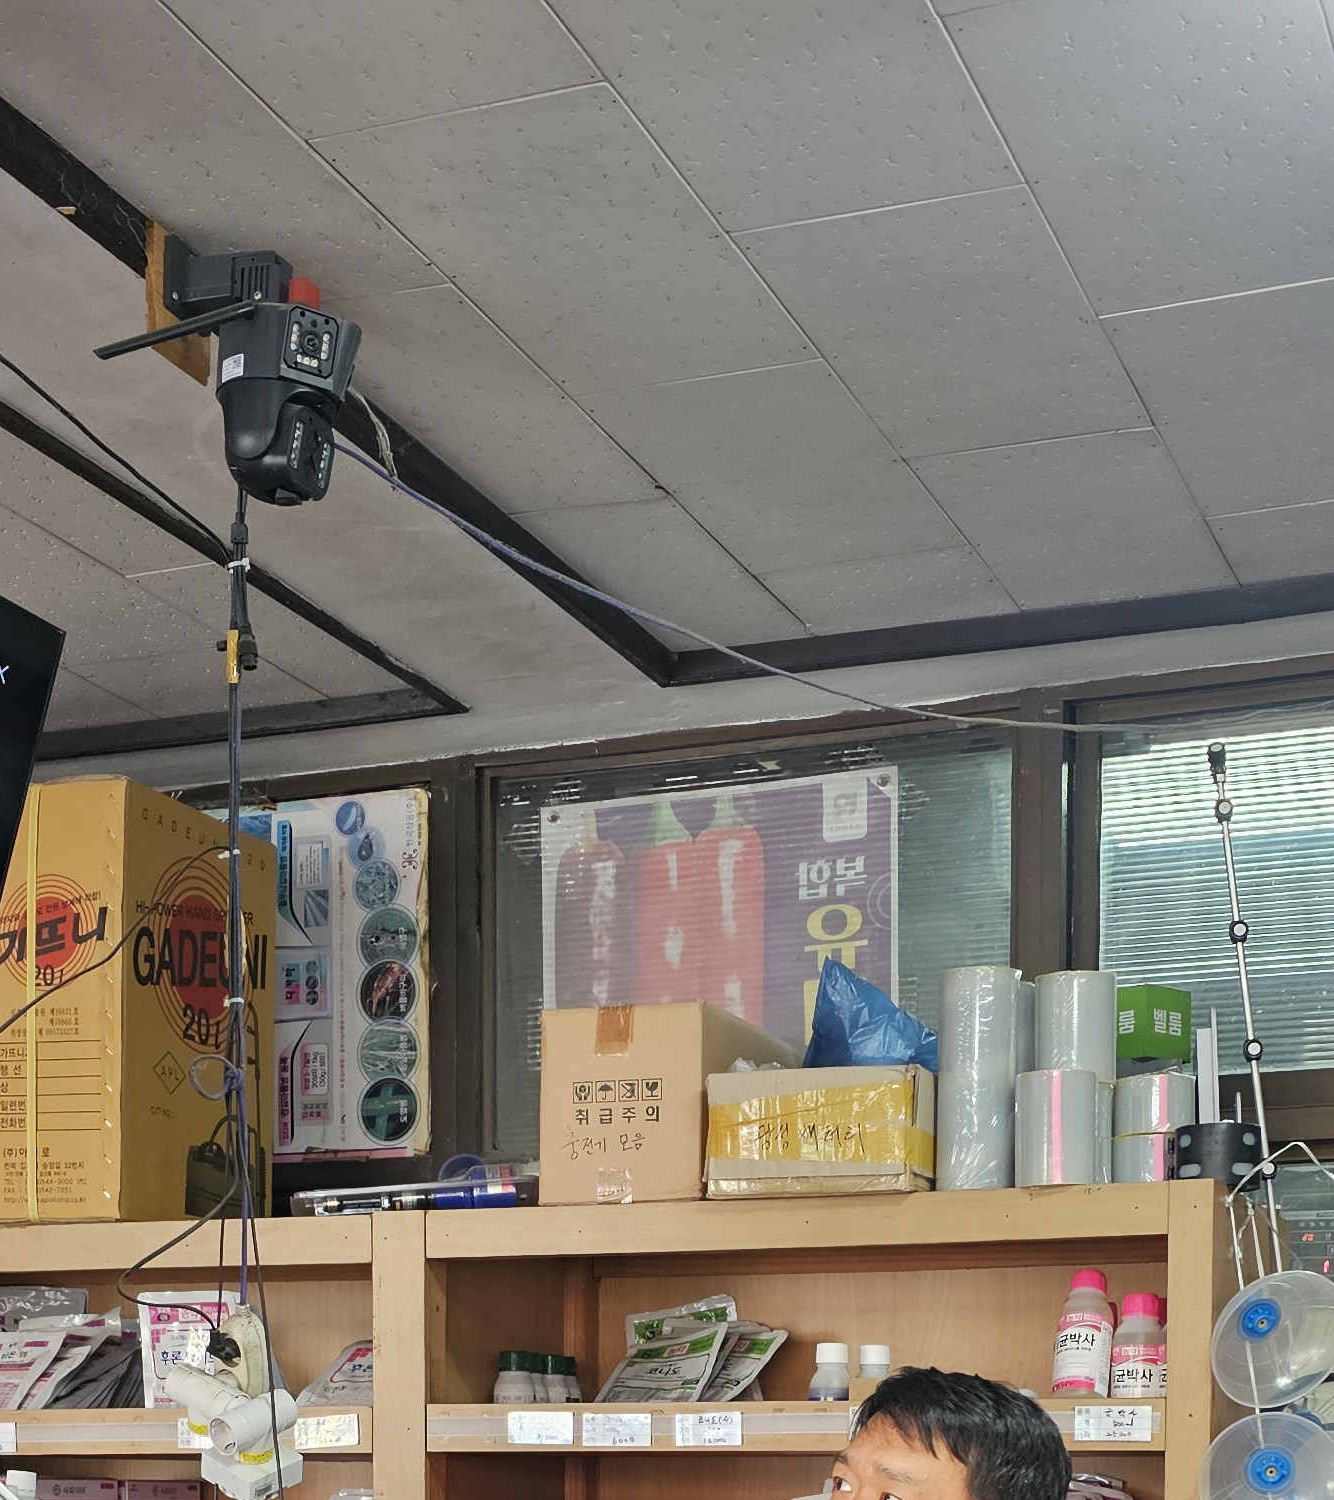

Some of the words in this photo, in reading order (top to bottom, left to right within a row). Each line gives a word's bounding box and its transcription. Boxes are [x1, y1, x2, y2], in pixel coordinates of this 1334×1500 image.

[186, 907, 211, 920] HAND
[575, 1106, 660, 1125] 취급주의
[0, 1118, 26, 1128] 전화번
